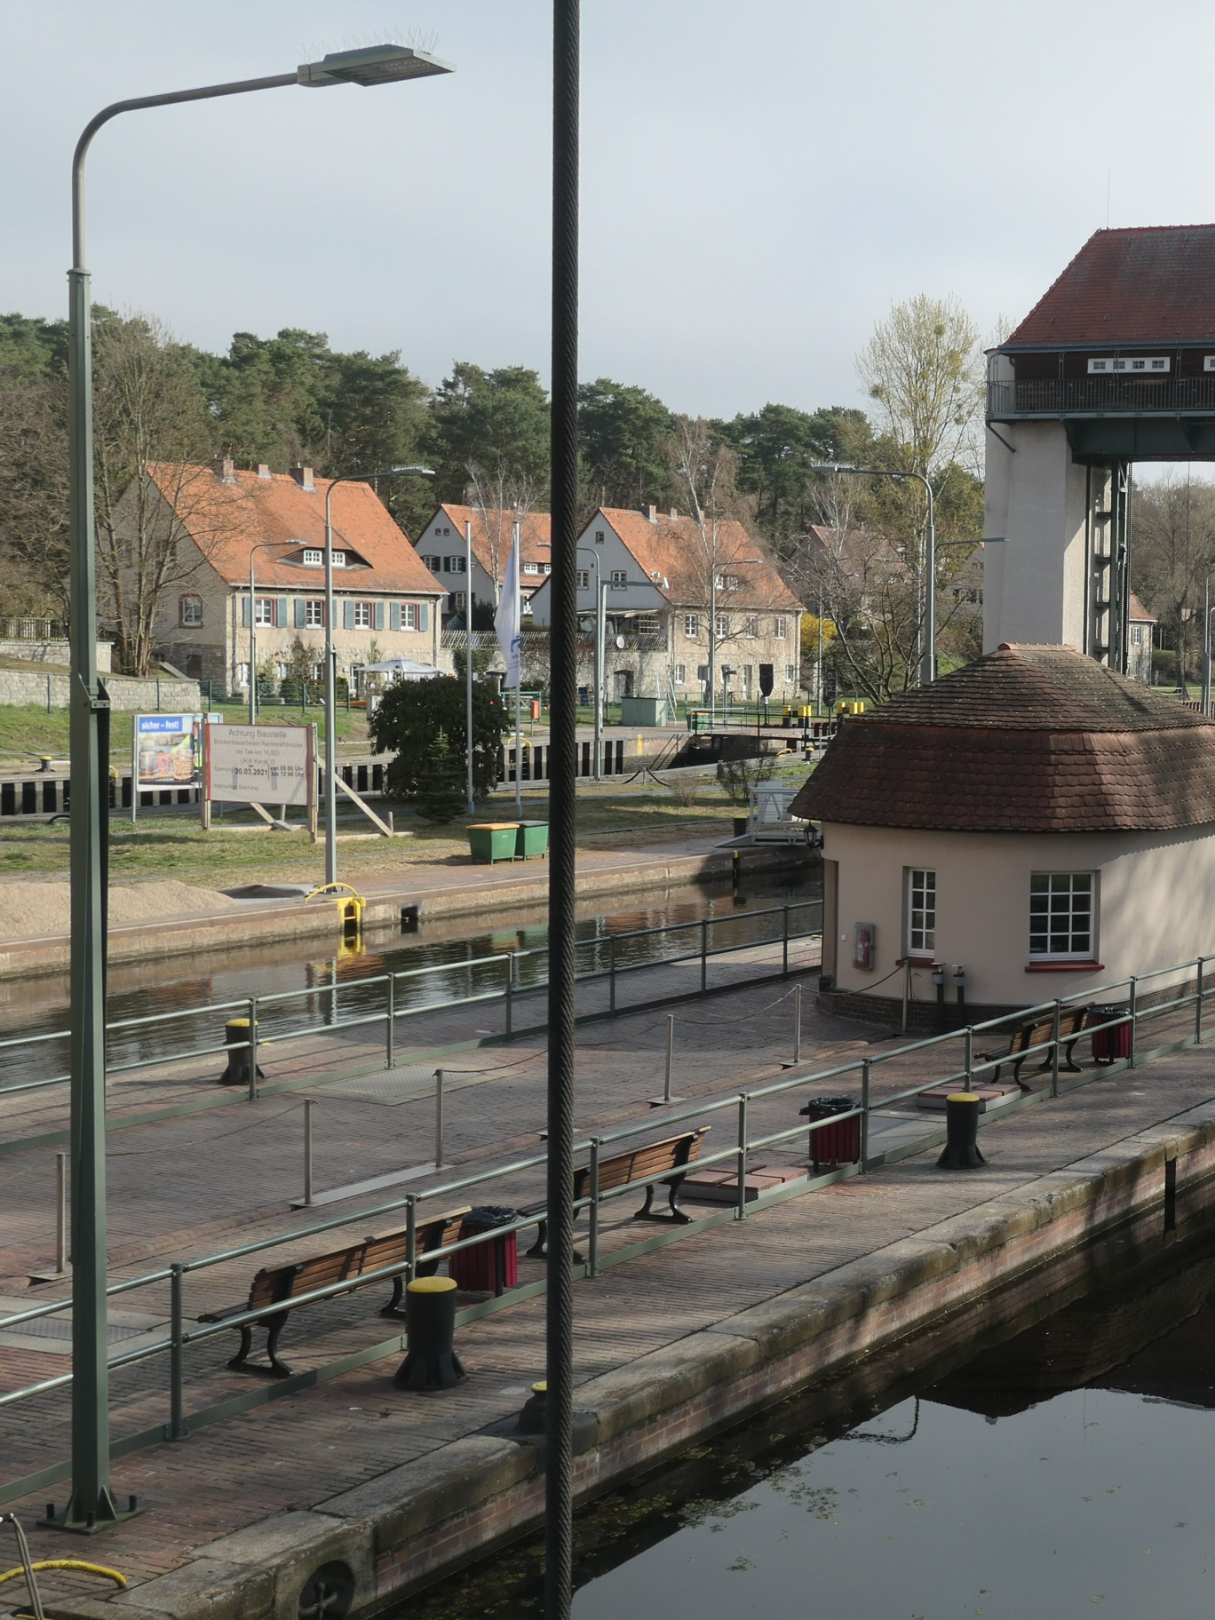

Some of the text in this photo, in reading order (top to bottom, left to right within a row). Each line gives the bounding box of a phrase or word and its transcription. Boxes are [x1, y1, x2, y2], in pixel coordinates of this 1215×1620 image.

[142, 720, 160, 730] sicher
[166, 720, 178, 729] fest!
[228, 728, 286, 738] Achtung Baustelle
[234, 767, 268, 776] 30.03.2021
